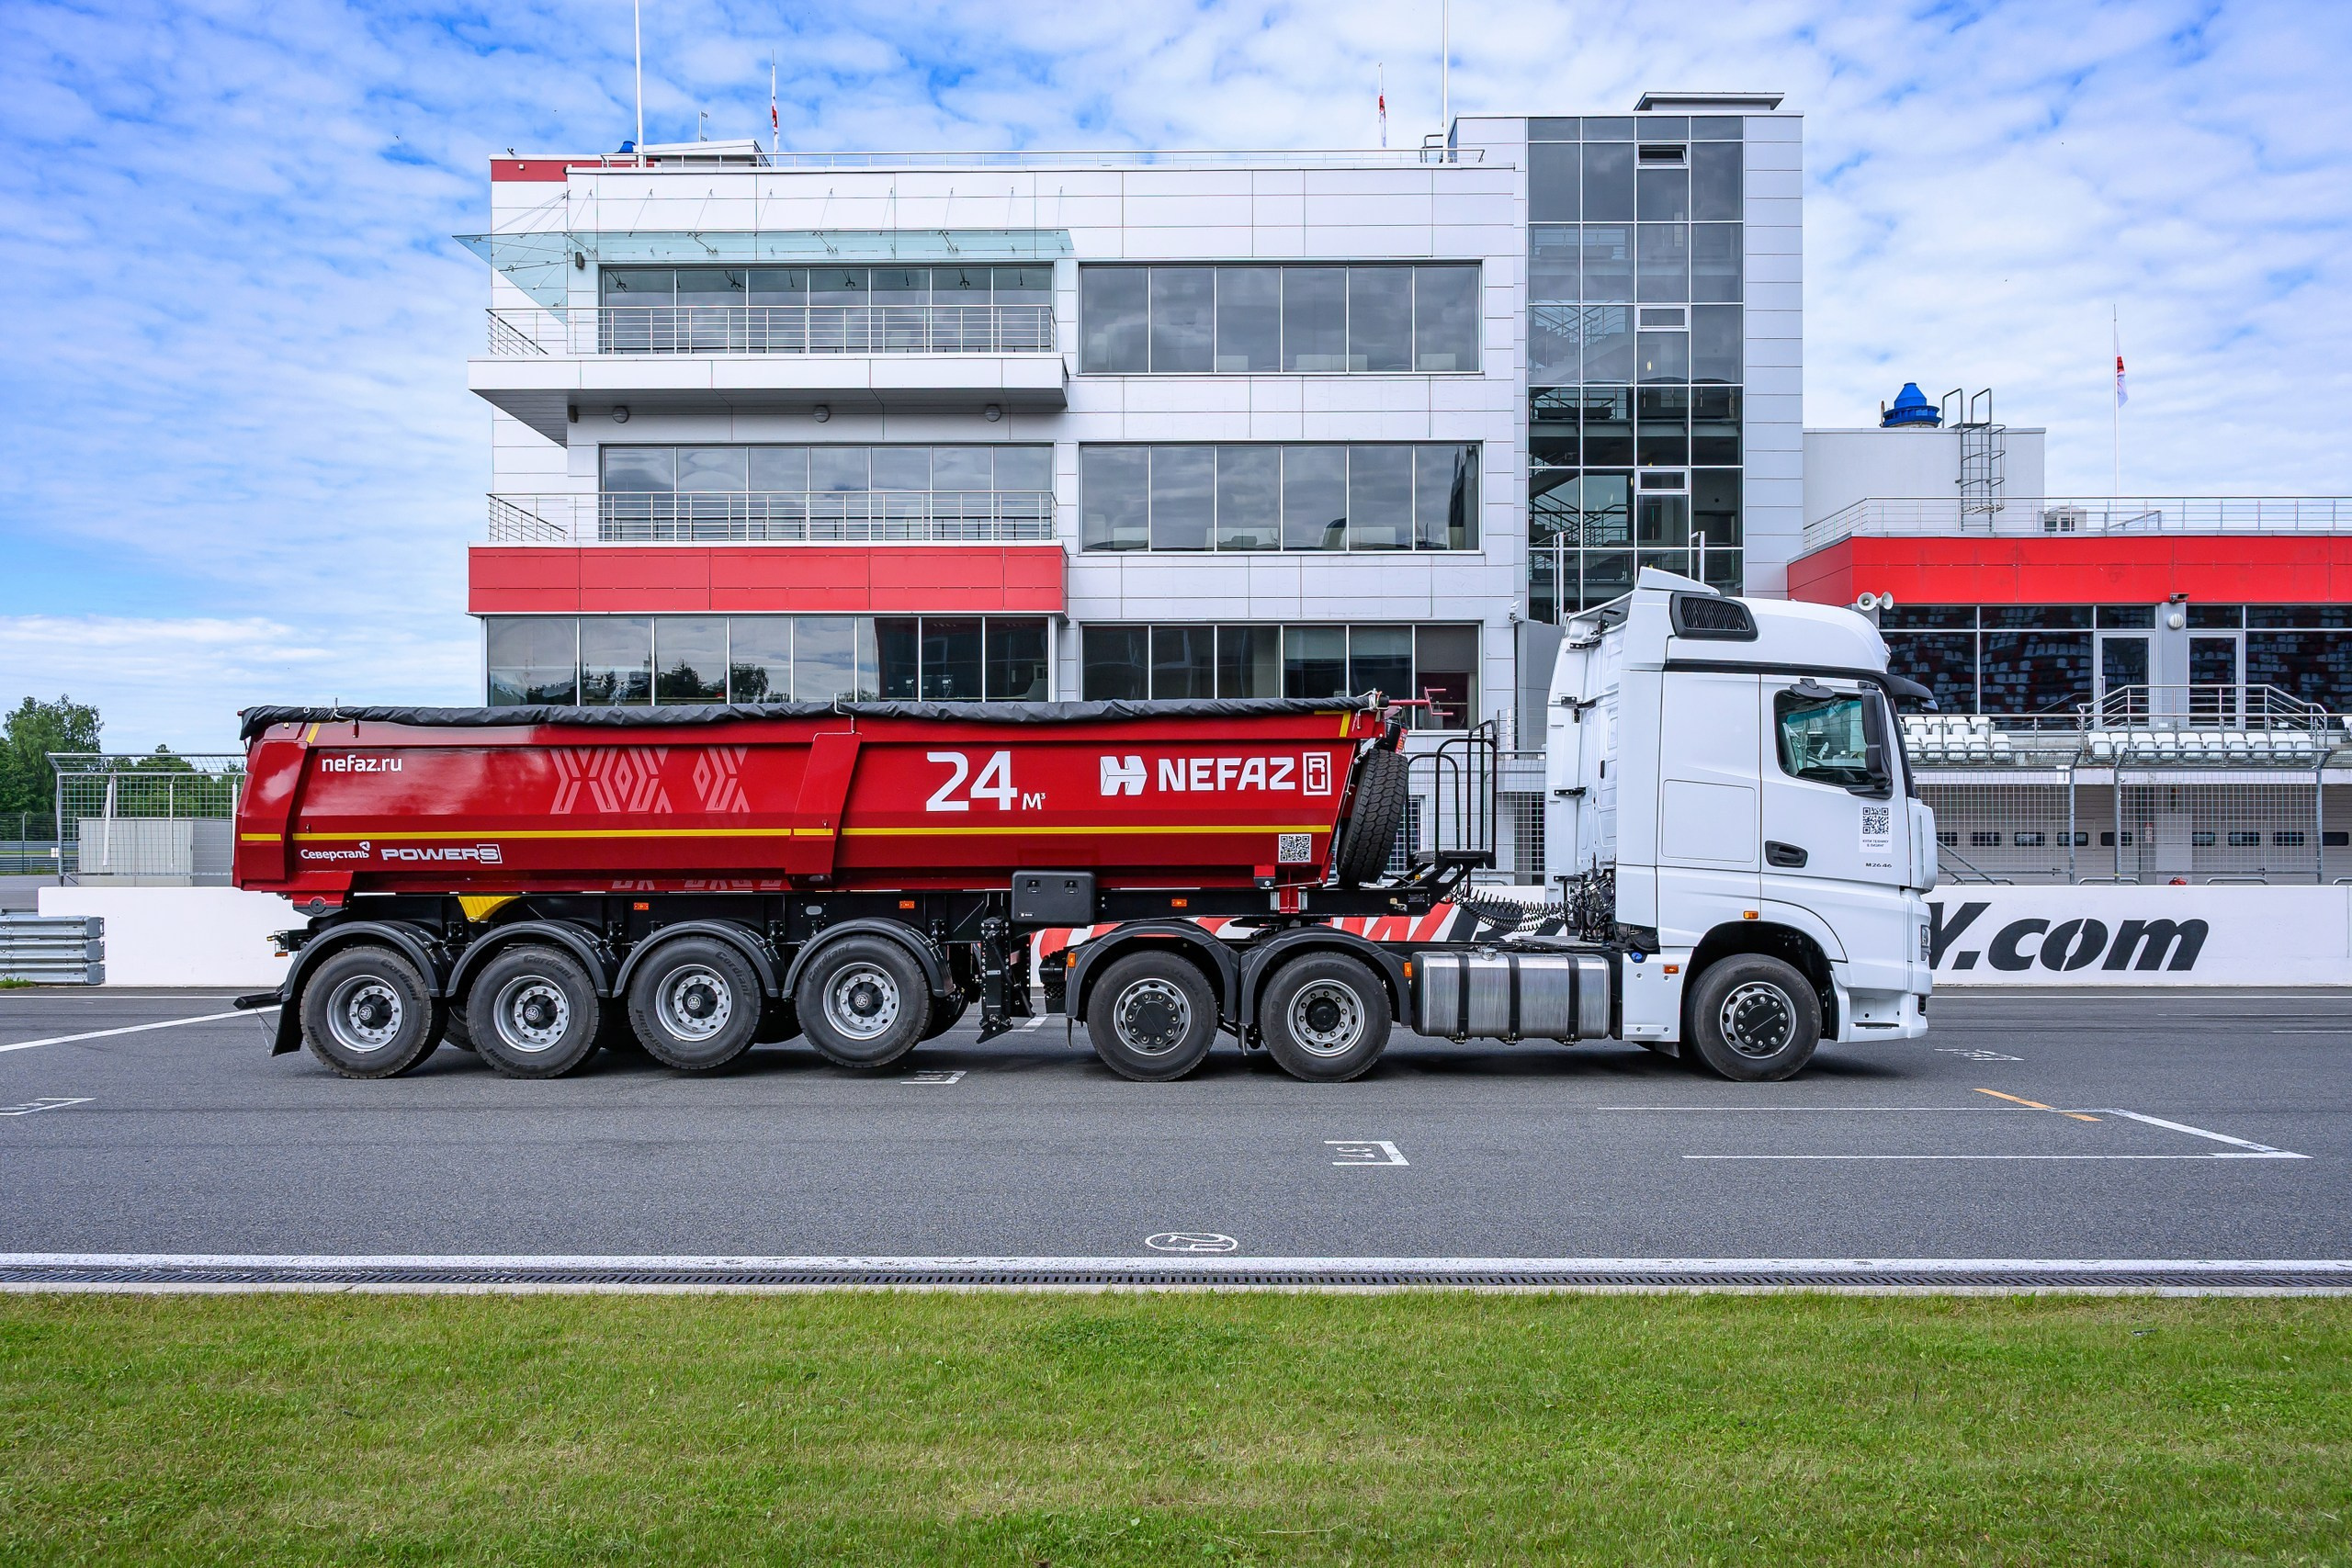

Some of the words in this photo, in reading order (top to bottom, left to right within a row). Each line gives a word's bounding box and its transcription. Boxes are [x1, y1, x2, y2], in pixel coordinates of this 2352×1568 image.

[322, 754, 402, 772] nefaz.ru
[1159, 757, 1295, 791] NEFAZ
[926, 751, 1017, 811] 24
[300, 847, 370, 862] Северсталь
[523, 954, 577, 980] Cordiant
[715, 951, 752, 998] Cordiant
